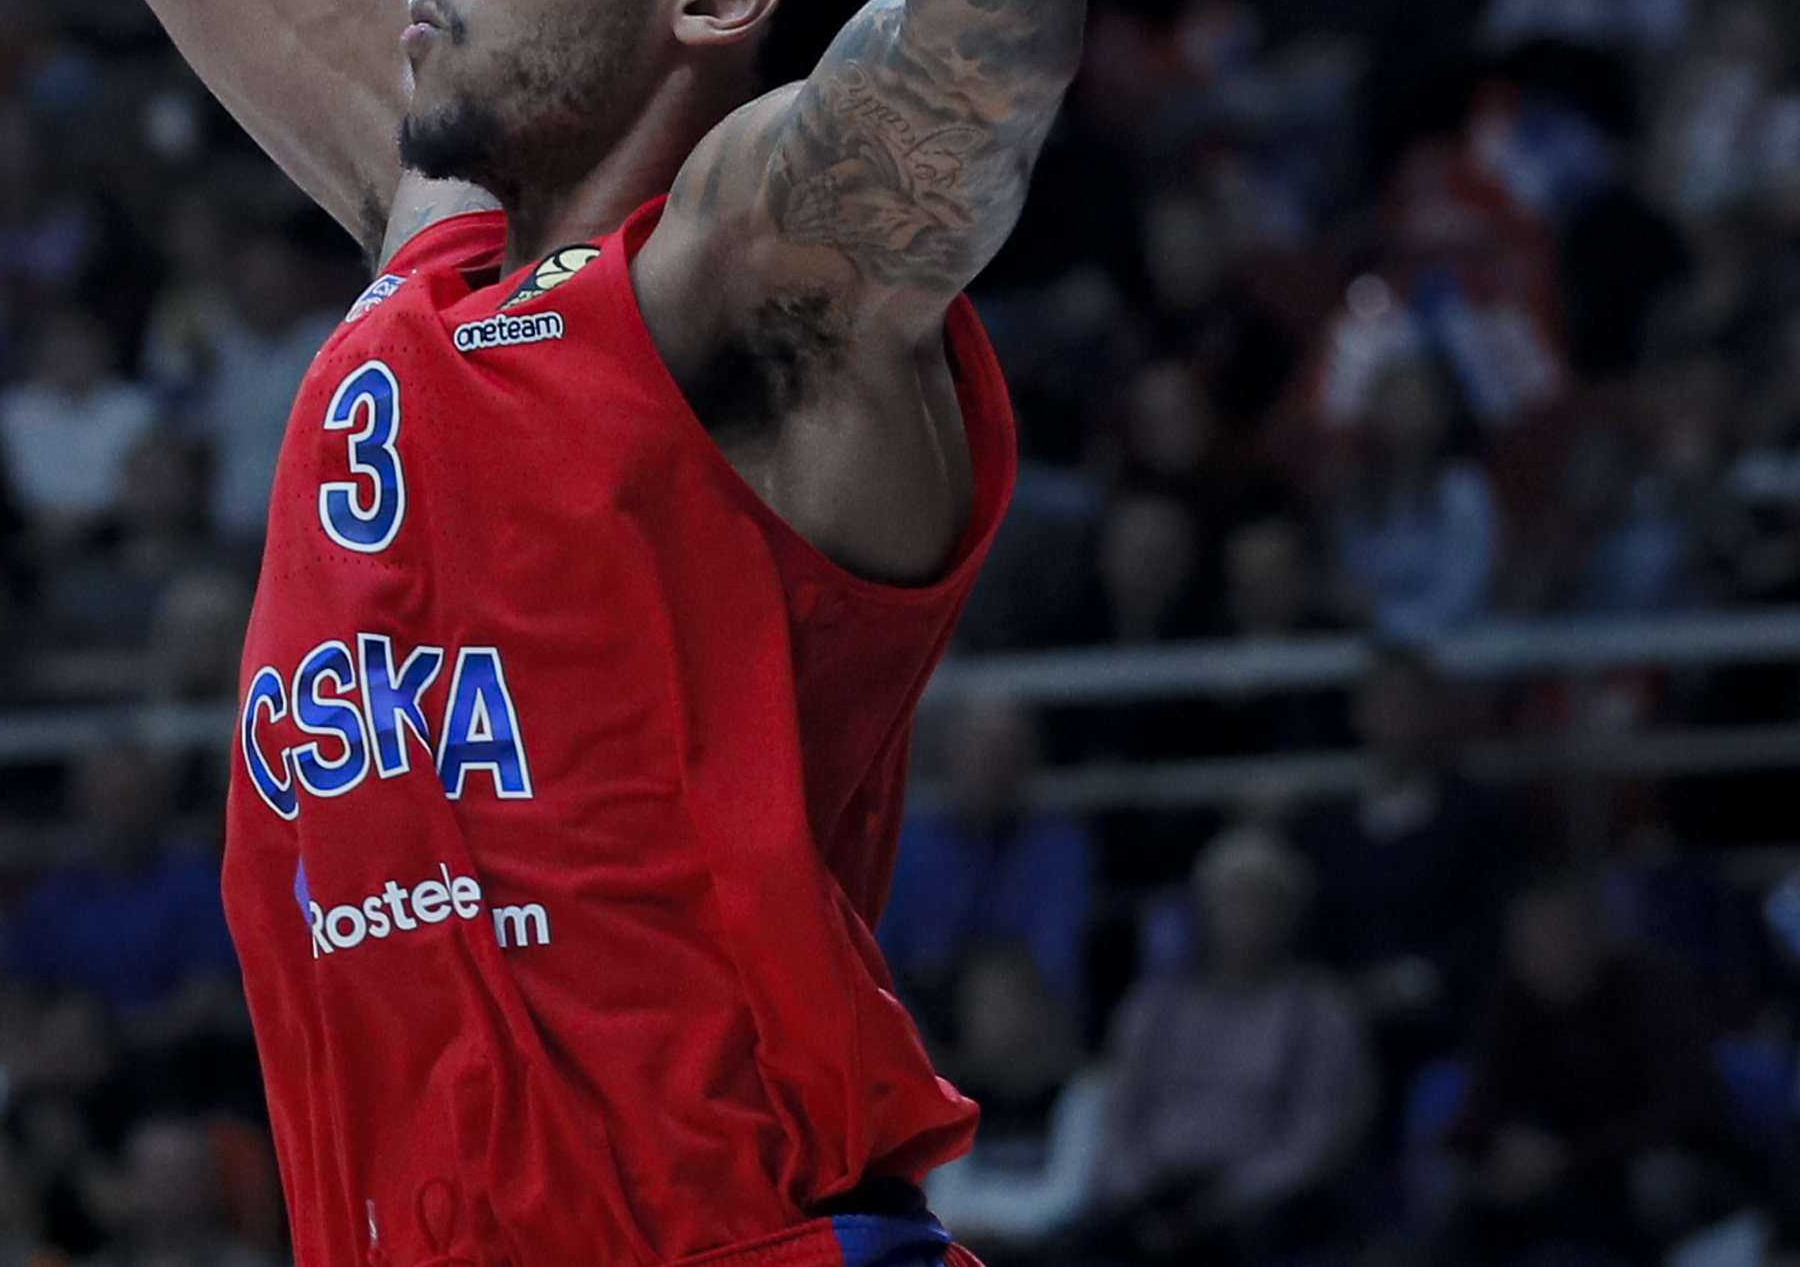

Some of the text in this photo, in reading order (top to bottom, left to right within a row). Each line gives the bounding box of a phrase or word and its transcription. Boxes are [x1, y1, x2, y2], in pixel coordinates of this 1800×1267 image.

[456, 312, 561, 350] oneteam
[318, 359, 406, 553] 3
[242, 632, 534, 821] CSKA
[309, 862, 550, 958] Rosteem
